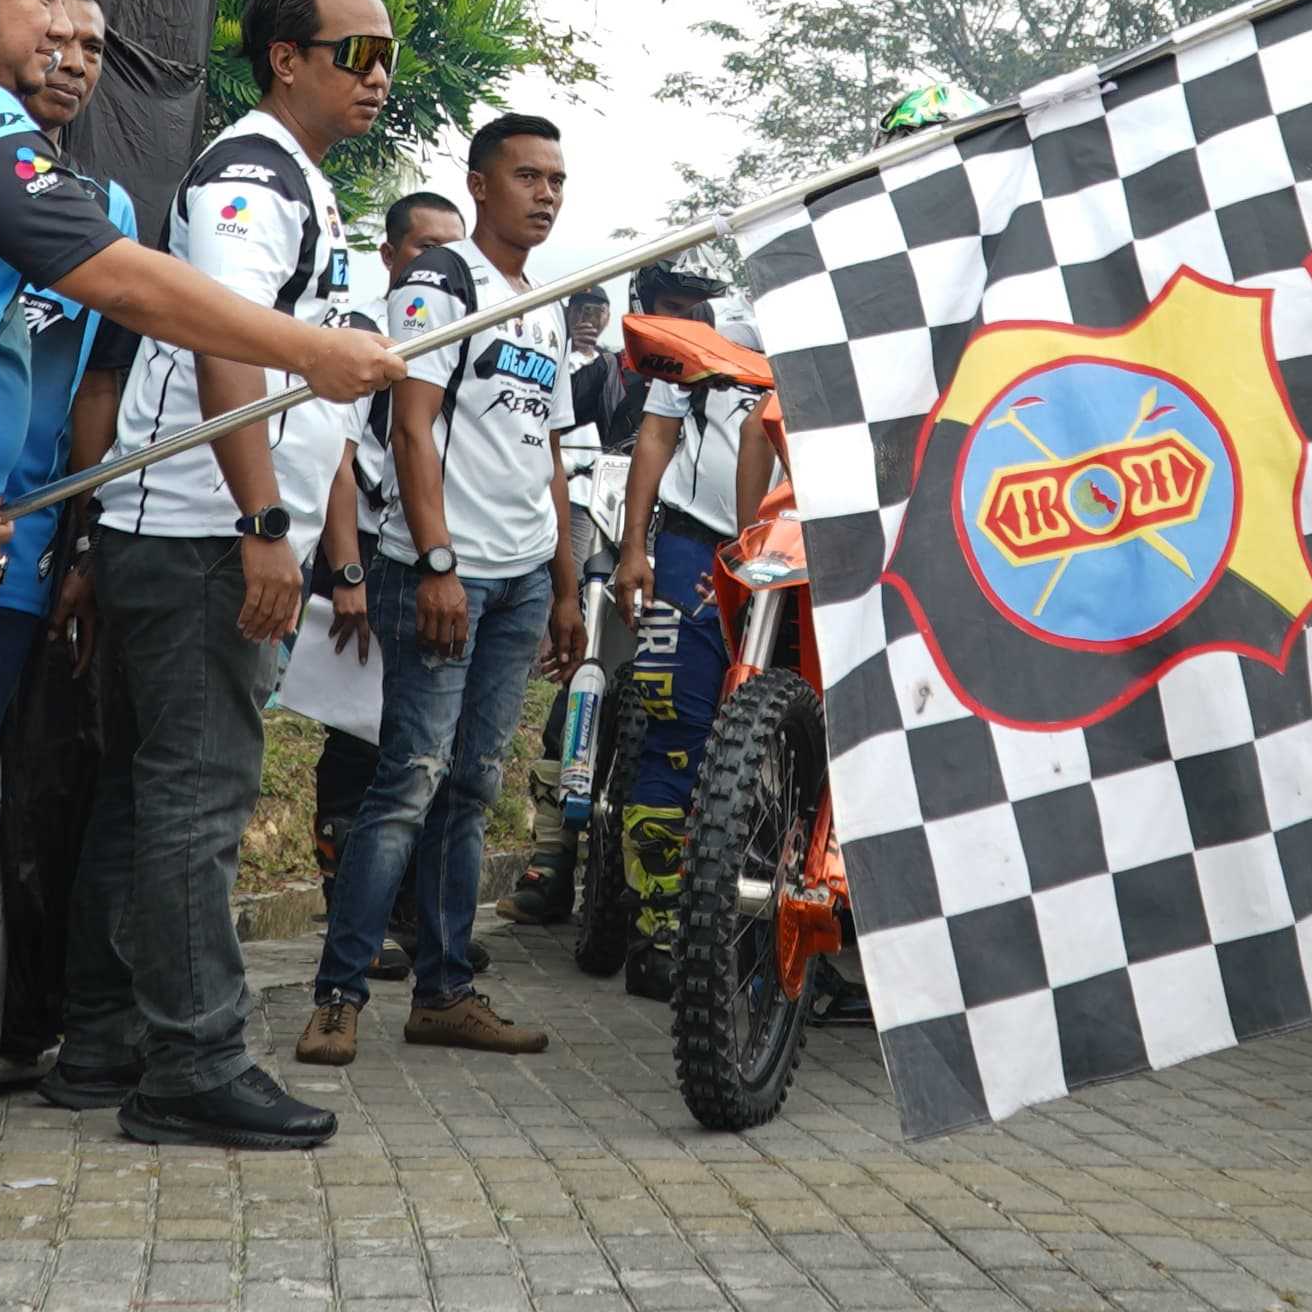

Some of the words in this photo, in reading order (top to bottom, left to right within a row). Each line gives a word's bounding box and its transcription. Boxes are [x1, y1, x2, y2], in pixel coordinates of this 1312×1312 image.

[220, 164, 276, 183] SIX
[26, 173, 59, 194] adw
[216, 222, 248, 235] adw
[407, 270, 448, 285] SIX
[403, 319, 425, 329] adw
[521, 434, 545, 448] SIX
